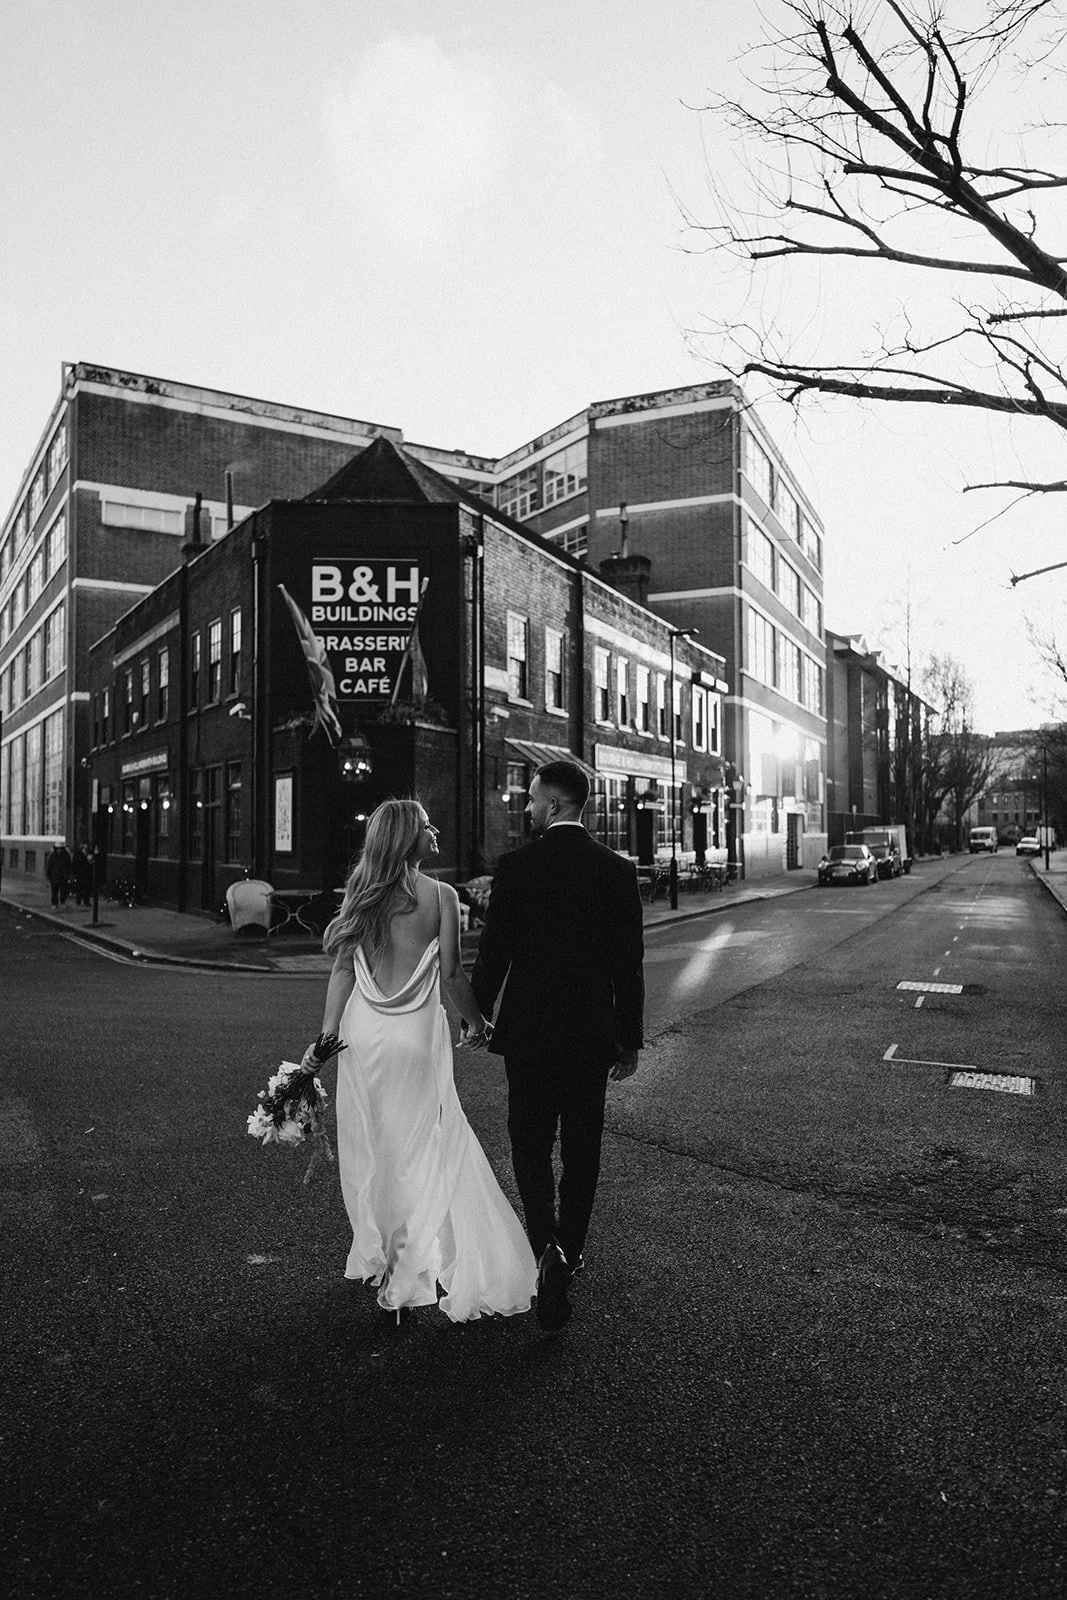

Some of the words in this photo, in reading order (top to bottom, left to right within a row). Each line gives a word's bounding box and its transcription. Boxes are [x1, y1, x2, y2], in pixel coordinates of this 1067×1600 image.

[311, 565, 419, 603] B&H
[311, 605, 418, 622] BUILDINGS
[313, 635, 410, 651] BRASSERI
[345, 657, 386, 672] BAR
[339, 675, 391, 693] CAFÉ
